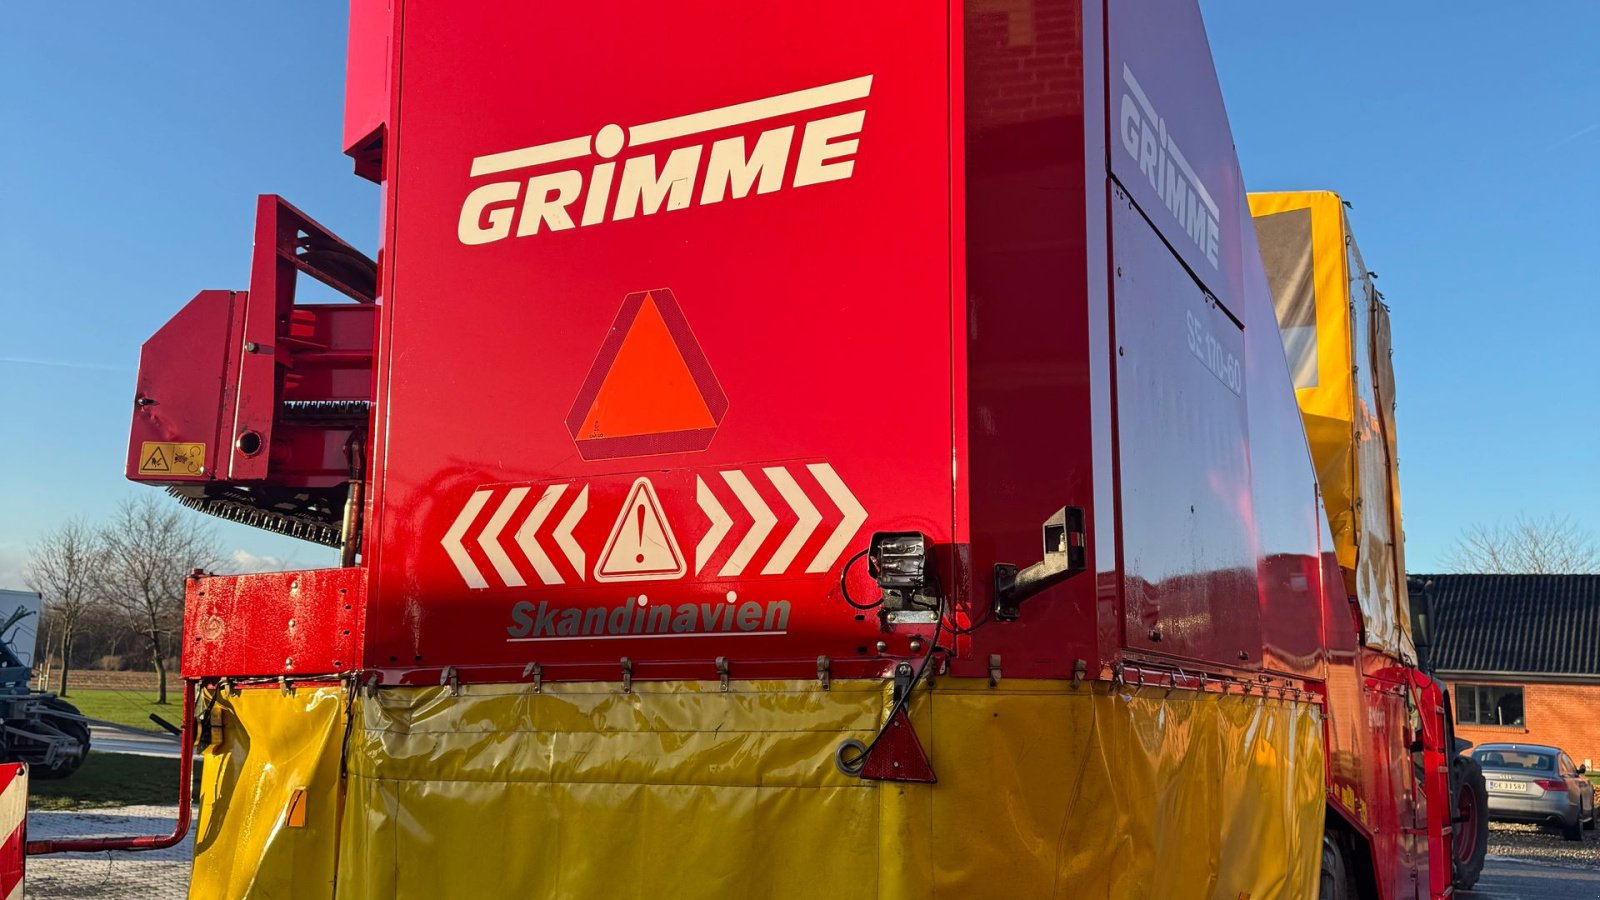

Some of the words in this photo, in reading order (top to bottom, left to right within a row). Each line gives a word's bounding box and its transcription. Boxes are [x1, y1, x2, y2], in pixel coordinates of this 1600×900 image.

[458, 109, 867, 246] GRIMME
[1120, 93, 1219, 271] GRIMME
[1186, 308, 1204, 360] SE
[507, 593, 792, 638] Skandinavien
